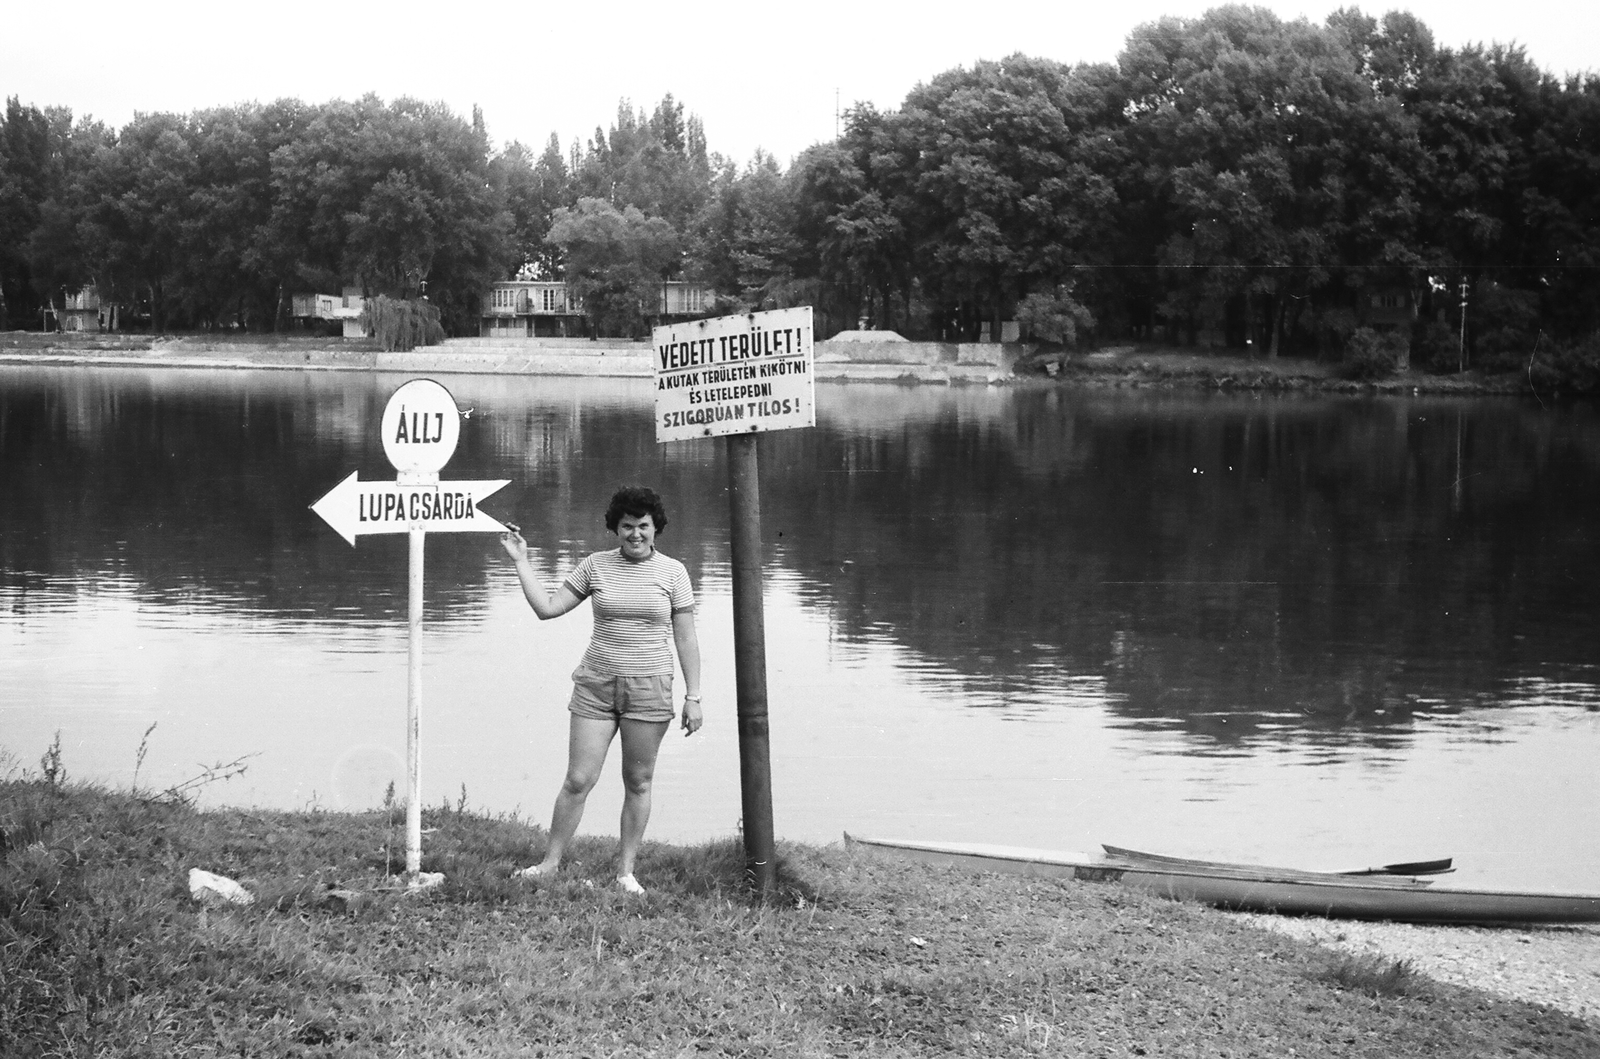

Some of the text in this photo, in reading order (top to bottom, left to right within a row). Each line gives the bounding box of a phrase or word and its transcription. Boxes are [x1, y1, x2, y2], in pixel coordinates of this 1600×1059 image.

[659, 327, 801, 369] VÉDETT TERÜLET!
[658, 360, 806, 390] A KUTAK TERÜLETÉN KIKÖTNI
[690, 384, 772, 404] ÉS LETELEPEDNI
[395, 404, 443, 444] ÁLLJ
[359, 494, 406, 521] LUPA
